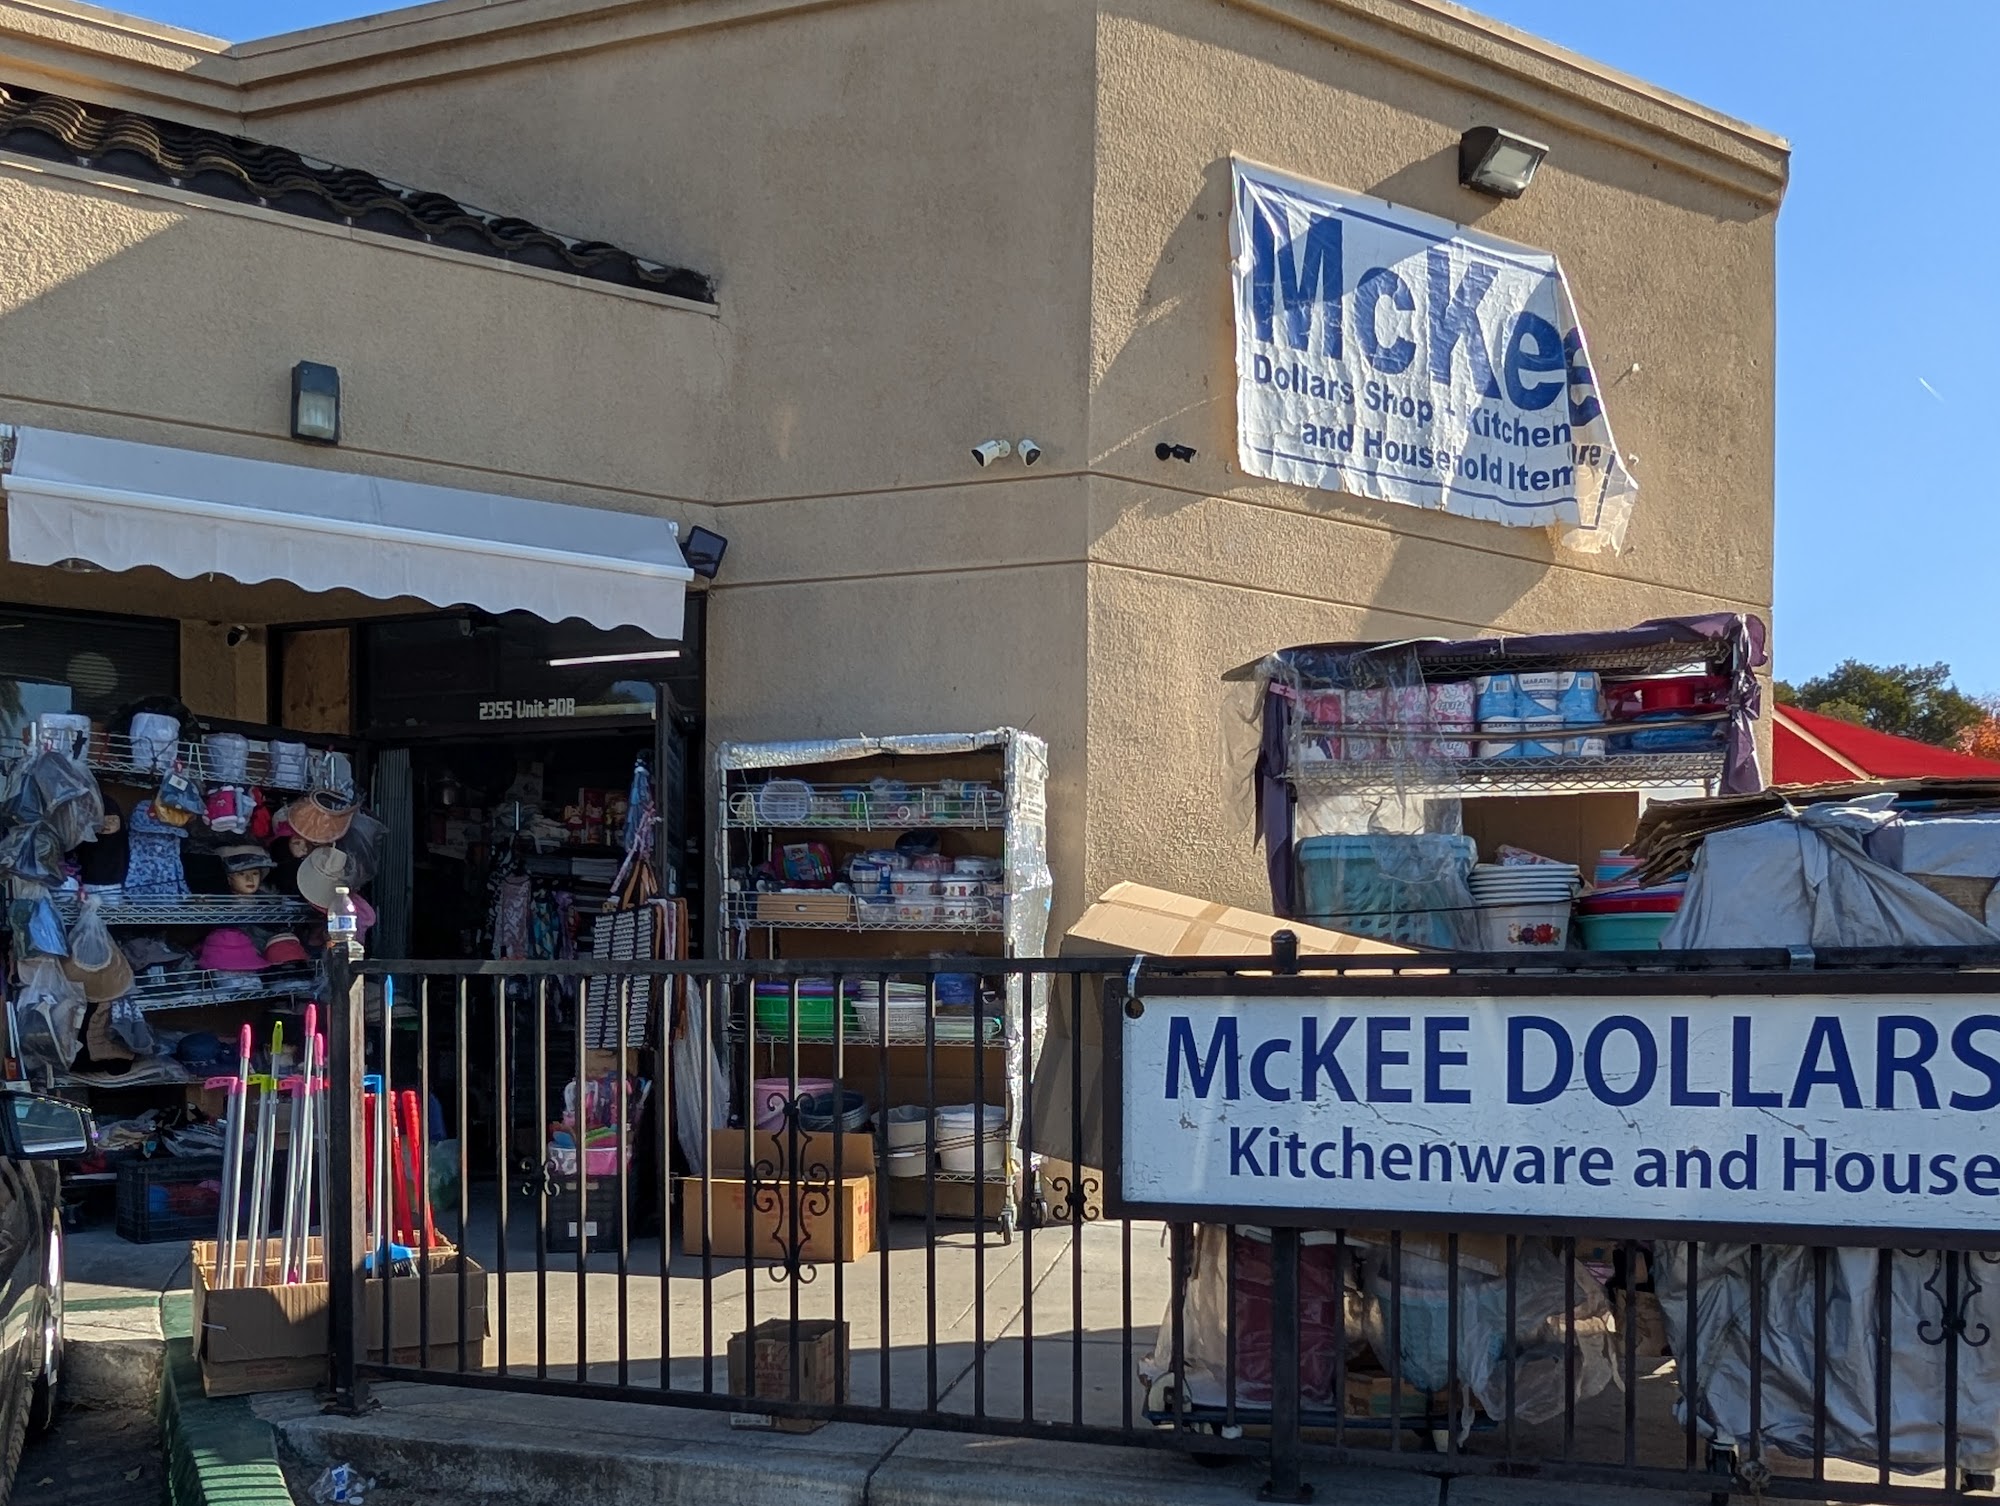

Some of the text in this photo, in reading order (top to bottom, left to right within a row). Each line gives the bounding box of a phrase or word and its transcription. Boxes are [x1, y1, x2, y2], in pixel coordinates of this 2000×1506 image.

[1254, 353, 1354, 405] Dollars
[1364, 381, 1433, 428] Shop
[1302, 422, 1355, 453] and
[1364, 428, 1503, 486] Household
[480, 698, 575, 720] 2355 Unit 20B
[1165, 1014, 2000, 1111] McKEE DOLLARS
[1230, 1126, 2000, 1196] Kitchenware and House
